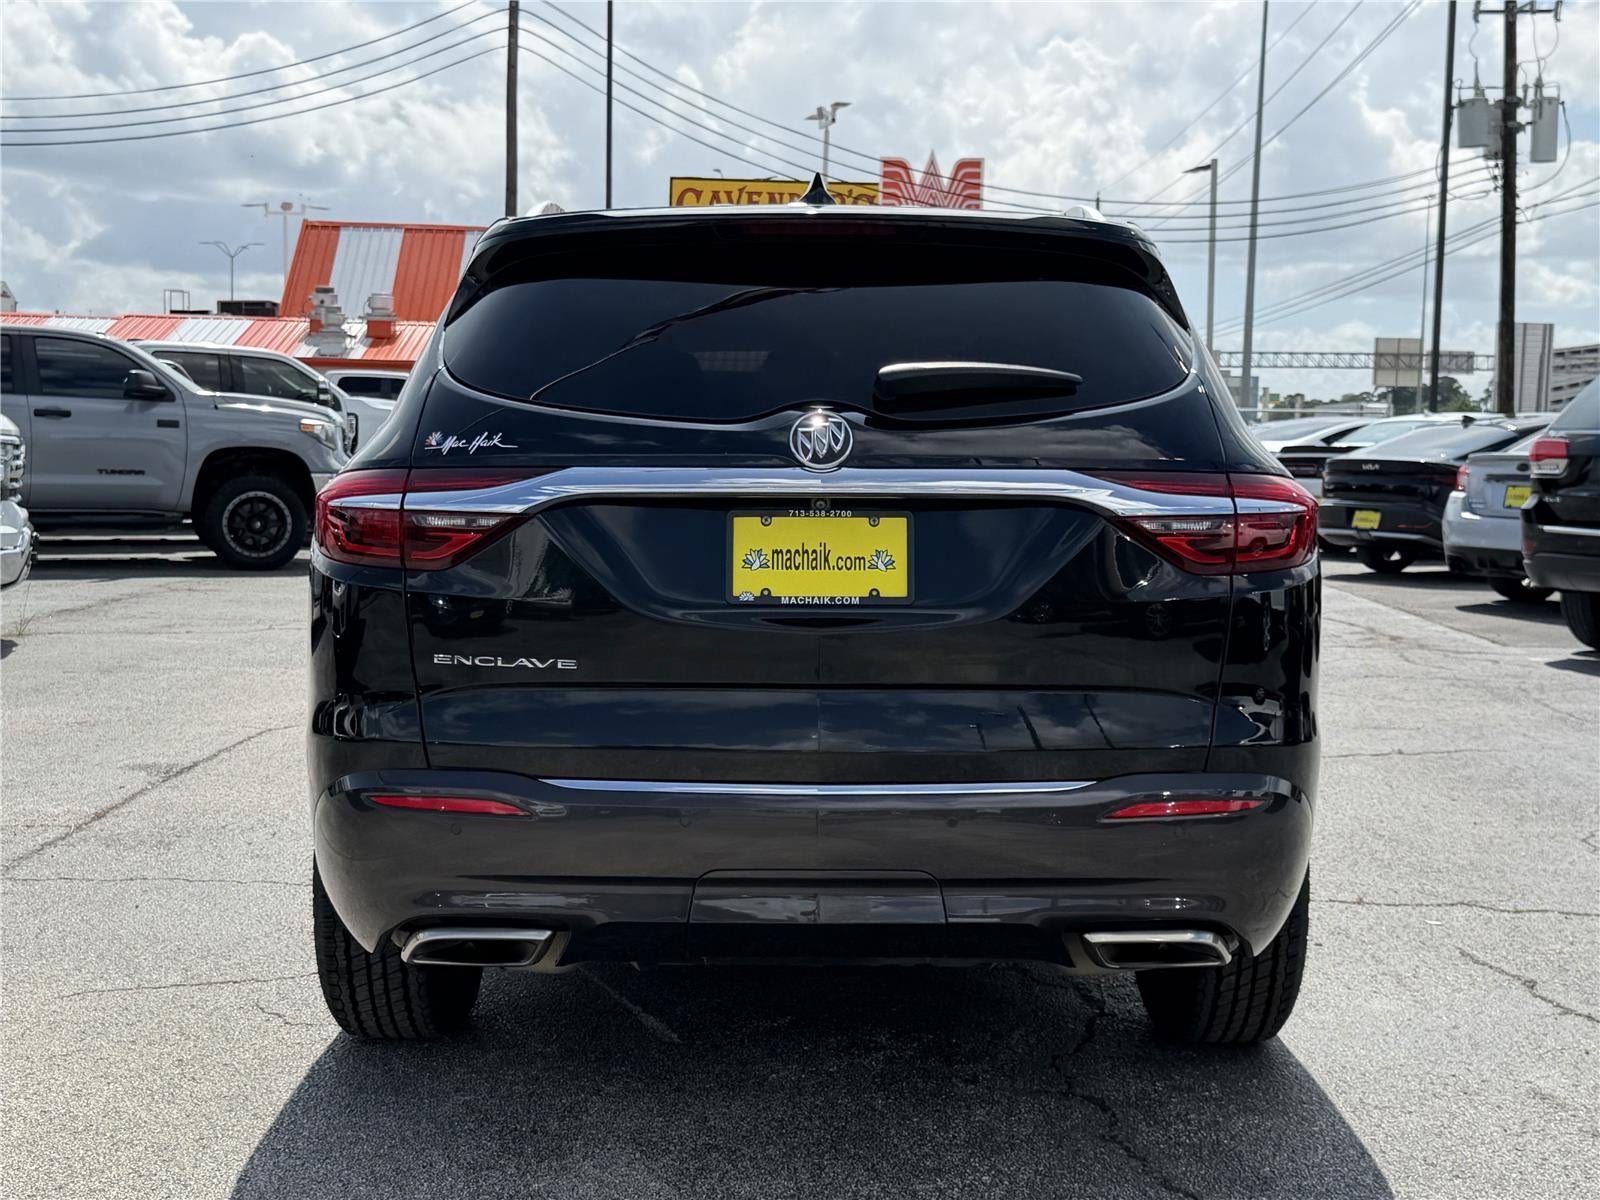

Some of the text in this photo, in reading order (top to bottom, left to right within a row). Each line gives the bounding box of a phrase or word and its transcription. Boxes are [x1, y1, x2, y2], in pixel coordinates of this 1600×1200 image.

[424, 431, 519, 456] Mac Haik
[96, 468, 146, 476] TUNDRA
[788, 510, 852, 518] 713-538-2700
[771, 542, 866, 571] machaik.com
[780, 596, 860, 605] MACHAIK.COM
[433, 653, 578, 670] ENCLAVE
